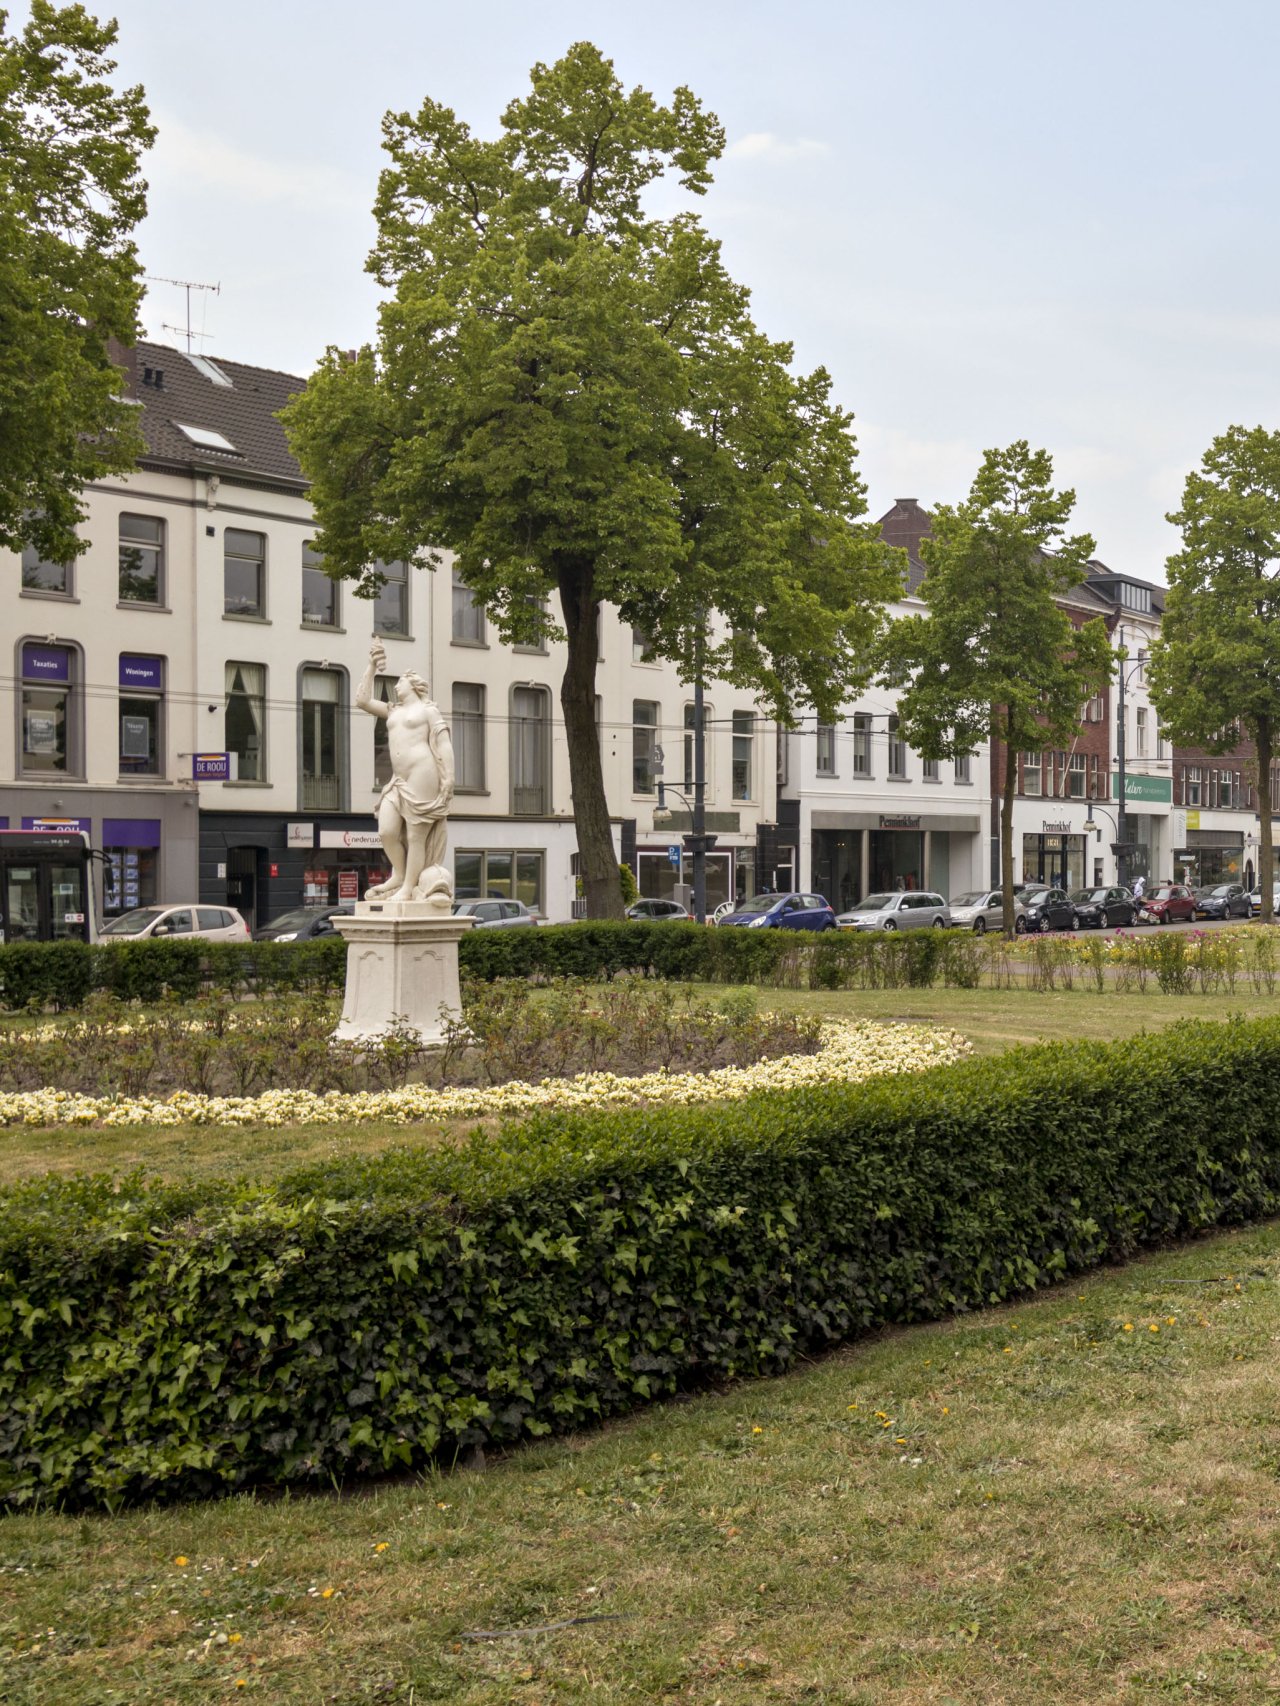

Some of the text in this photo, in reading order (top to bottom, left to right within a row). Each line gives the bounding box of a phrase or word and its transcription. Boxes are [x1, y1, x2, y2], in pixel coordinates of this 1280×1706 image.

[33, 659, 58, 669] Taxaties
[125, 668, 154, 677] Woningen
[197, 762, 206, 772] DE
